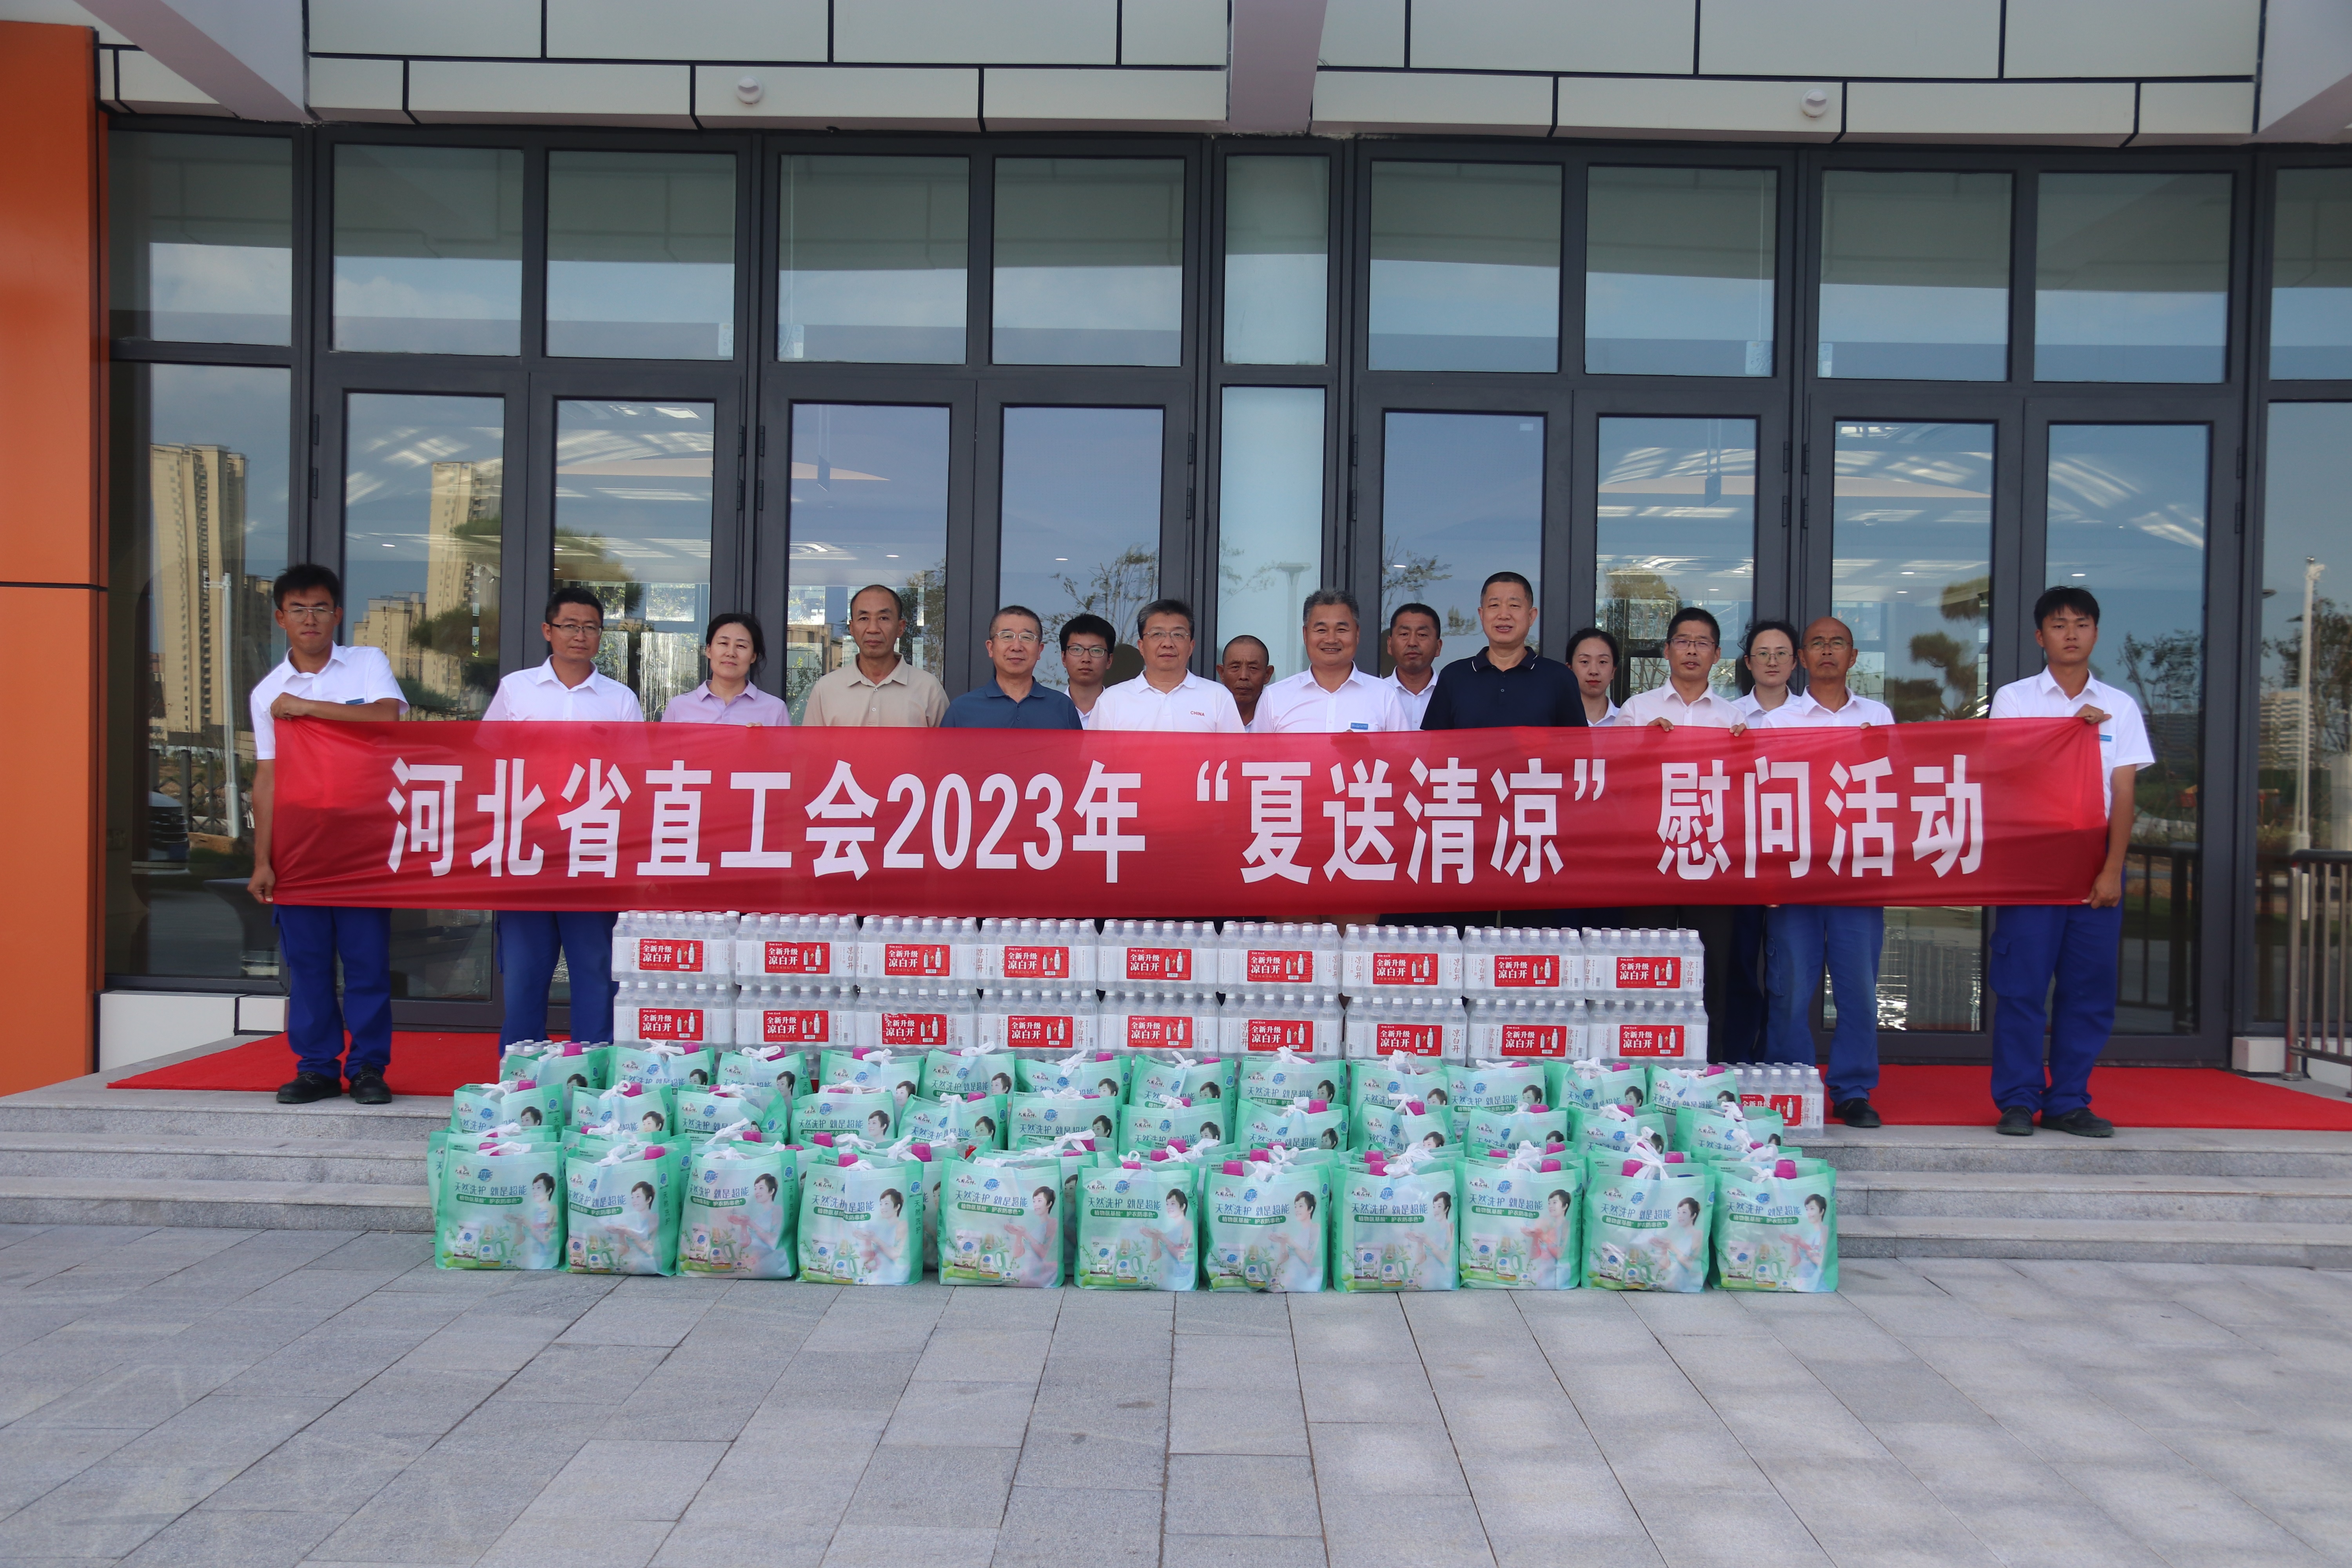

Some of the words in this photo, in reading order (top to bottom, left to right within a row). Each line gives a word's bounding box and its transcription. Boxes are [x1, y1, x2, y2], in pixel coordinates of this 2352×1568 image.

[642, 953, 672, 963] 凉白开
[768, 955, 798, 965] 凉白开
[889, 958, 918, 967] 凉白开
[1008, 960, 1037, 969] 凉白开
[1131, 962, 1159, 971] 凉白开
[1251, 964, 1280, 974] 凉白开
[1377, 967, 1406, 976] 凉白开
[1498, 969, 1527, 979] 凉白开
[1620, 971, 1648, 980] 凉白开
[643, 1022, 671, 1031] 凉白开
[768, 1024, 796, 1034] 凉白开
[886, 1027, 915, 1037] 凉白开
[1012, 1029, 1041, 1039] 凉白开
[1131, 1029, 1160, 1039] 凉白开
[1252, 1033, 1281, 1043] 凉白开
[1380, 1038, 1410, 1047] 凉白开
[1452, 1029, 1461, 1054] 凉白开
[1506, 1039, 1534, 1048] 凉白开
[1623, 1039, 1652, 1048] 凉白开
[647, 1065, 661, 1074] 超能
[1272, 1074, 1286, 1083] 超能
[931, 1080, 961, 1091] 天然洗护
[963, 1082, 989, 1091] 就是超能
[1474, 1084, 1487, 1092] 超能
[1247, 1086, 1279, 1097] 天然洗护
[1282, 1089, 1313, 1099] 就是超能
[1451, 1095, 1482, 1105] 天然洗护
[1486, 1094, 1518, 1105] 就是超能
[1652, 1093, 1679, 1108] 天然洗护
[480, 1110, 494, 1118] 超能
[703, 1107, 717, 1116] 超能
[819, 1105, 833, 1113] 超能
[1043, 1111, 1058, 1120] 超能
[682, 1118, 710, 1131] 天然洗护
[799, 1119, 826, 1129] 天然洗护
[829, 1119, 863, 1129] 就是超能
[1019, 1123, 1052, 1134] 天然洗护
[1159, 1122, 1172, 1131] 超能
[911, 1125, 943, 1140] 天然洗护
[1285, 1138, 1317, 1148] 就是超能
[1368, 1133, 1395, 1146] 天然洗护
[477, 1171, 493, 1179] 超能
[704, 1172, 719, 1181] 超能
[454, 1181, 486, 1195] 天然洗护
[490, 1185, 528, 1196] 就是超能
[689, 1183, 710, 1198] 天然洗护
[713, 1186, 750, 1199] 就是超能
[1114, 1182, 1130, 1191] 超能
[1497, 1182, 1513, 1191] 超能
[568, 1190, 591, 1205] 天然洗护
[592, 1194, 627, 1208] 就是超能
[955, 1190, 990, 1203] 天然洗护
[993, 1195, 1029, 1208] 就是超能
[1243, 1190, 1258, 1199] 超能
[1379, 1190, 1394, 1198] 超能
[1088, 1197, 1123, 1208] 天然洗护
[1127, 1198, 1161, 1211] 就是超能
[1468, 1193, 1505, 1207] 天然洗护
[1508, 1197, 1543, 1210] 就是超能
[961, 1203, 987, 1212] 植物氨基酸
[1215, 1203, 1252, 1216] 天然洗护
[1255, 1203, 1290, 1216] 就是超能
[1351, 1202, 1388, 1214] 天然洗护
[1392, 1203, 1428, 1215] 就是超能
[1475, 1207, 1503, 1215] 植物氨基酸
[1600, 1203, 1636, 1218] 天然洗护
[1726, 1201, 1764, 1214] 天然洗护
[1767, 1205, 1802, 1217] 就是超能
[1606, 1217, 1632, 1227] 植物氨基酸
